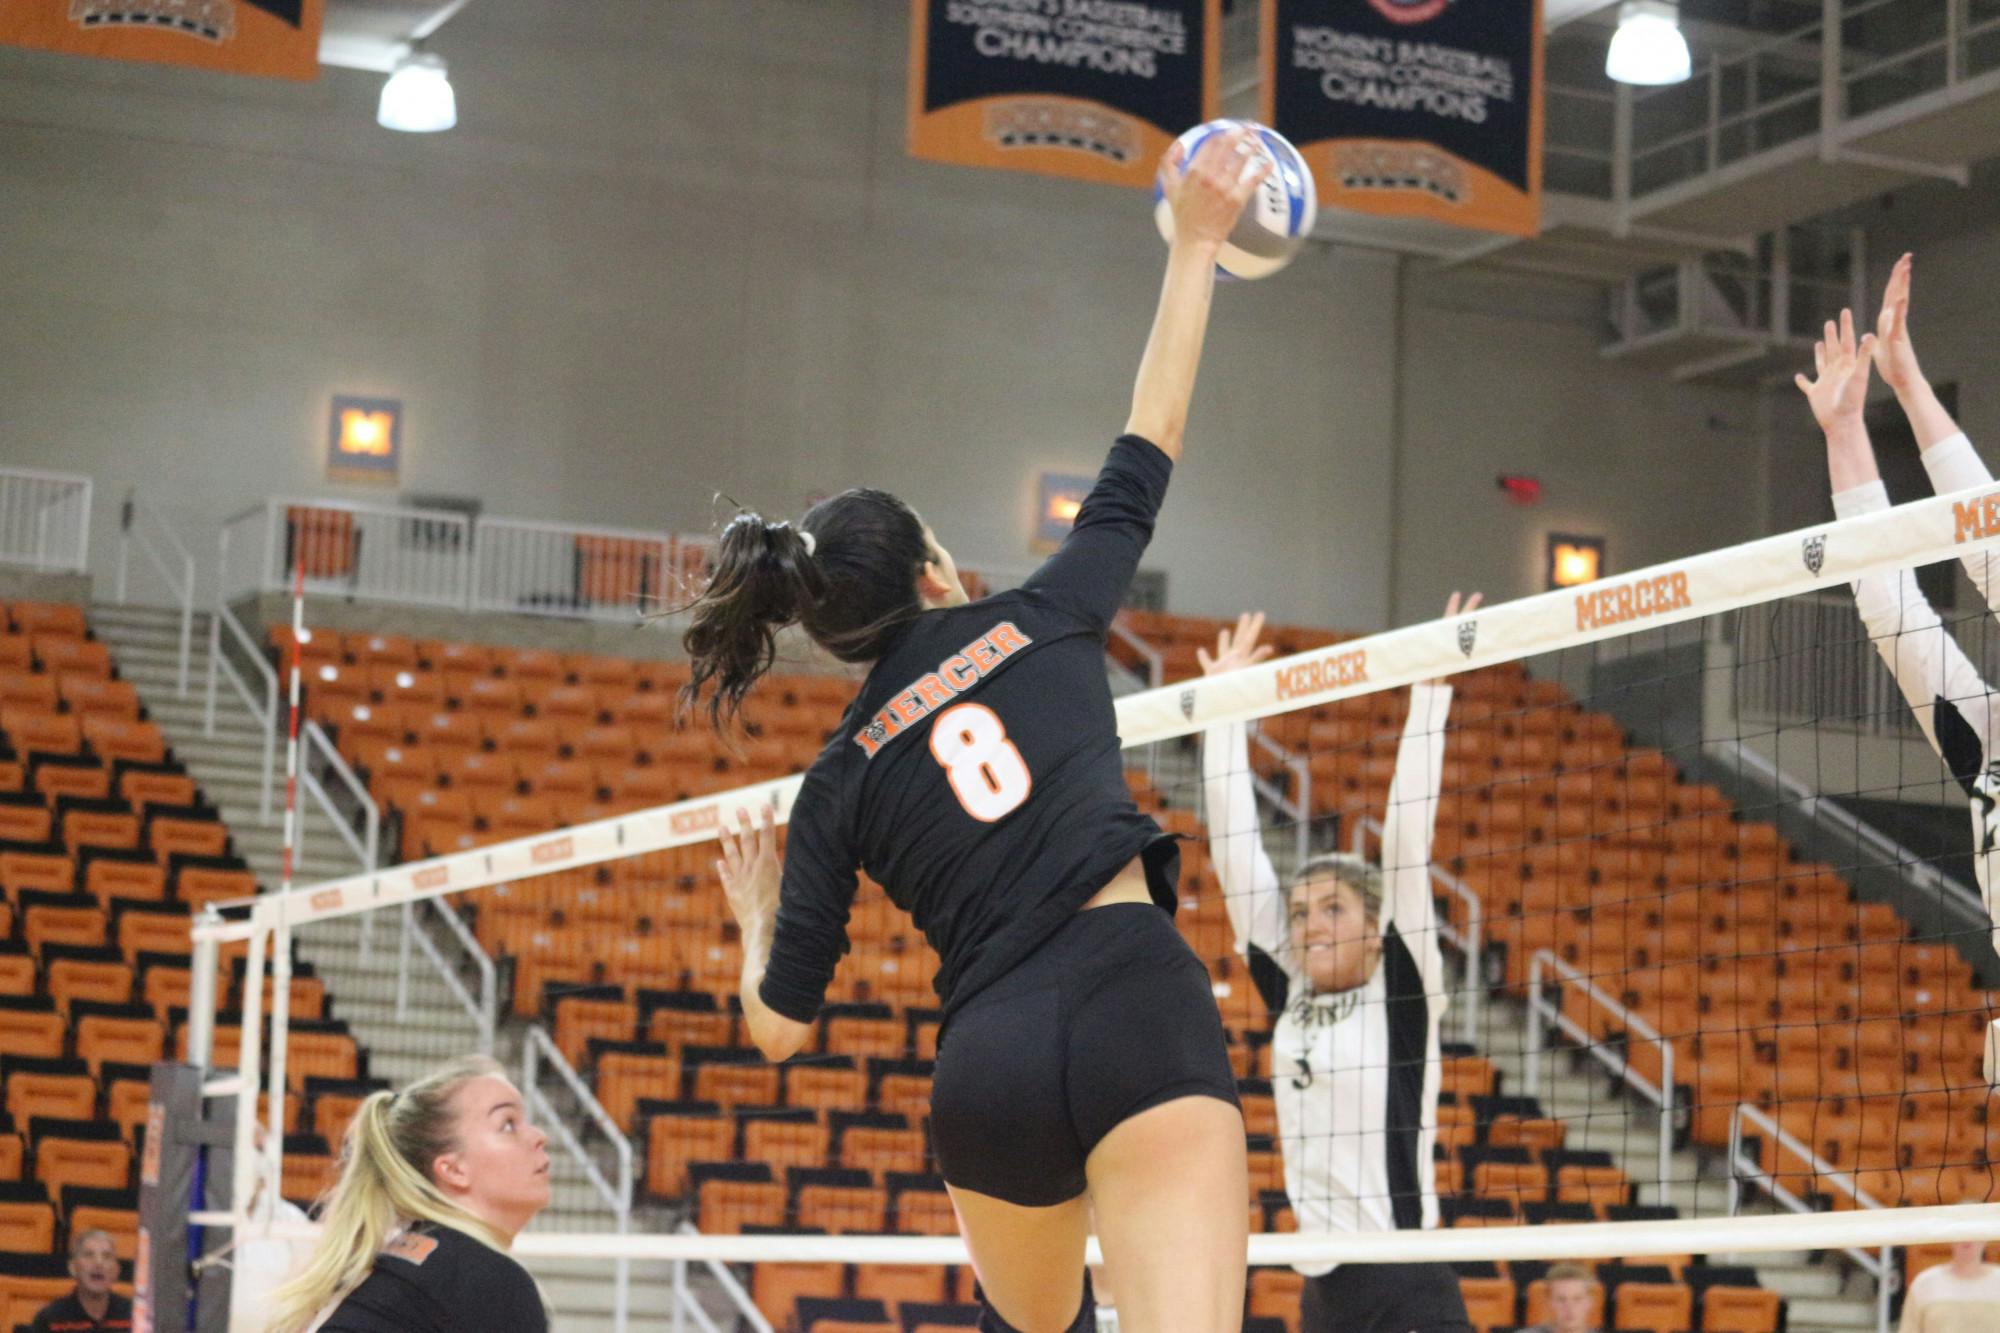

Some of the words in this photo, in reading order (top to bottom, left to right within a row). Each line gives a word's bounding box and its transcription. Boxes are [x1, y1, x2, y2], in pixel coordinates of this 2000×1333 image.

[974, 26, 1158, 78] CHAMPIONS
[1320, 72, 1488, 124] CHAMPIONS
[1575, 570, 1692, 632] MERCER
[853, 621, 1033, 759] MERCER
[1275, 649, 1369, 701] MERCER
[928, 702, 1033, 823] 8
[1292, 1055, 1313, 1090] 3
